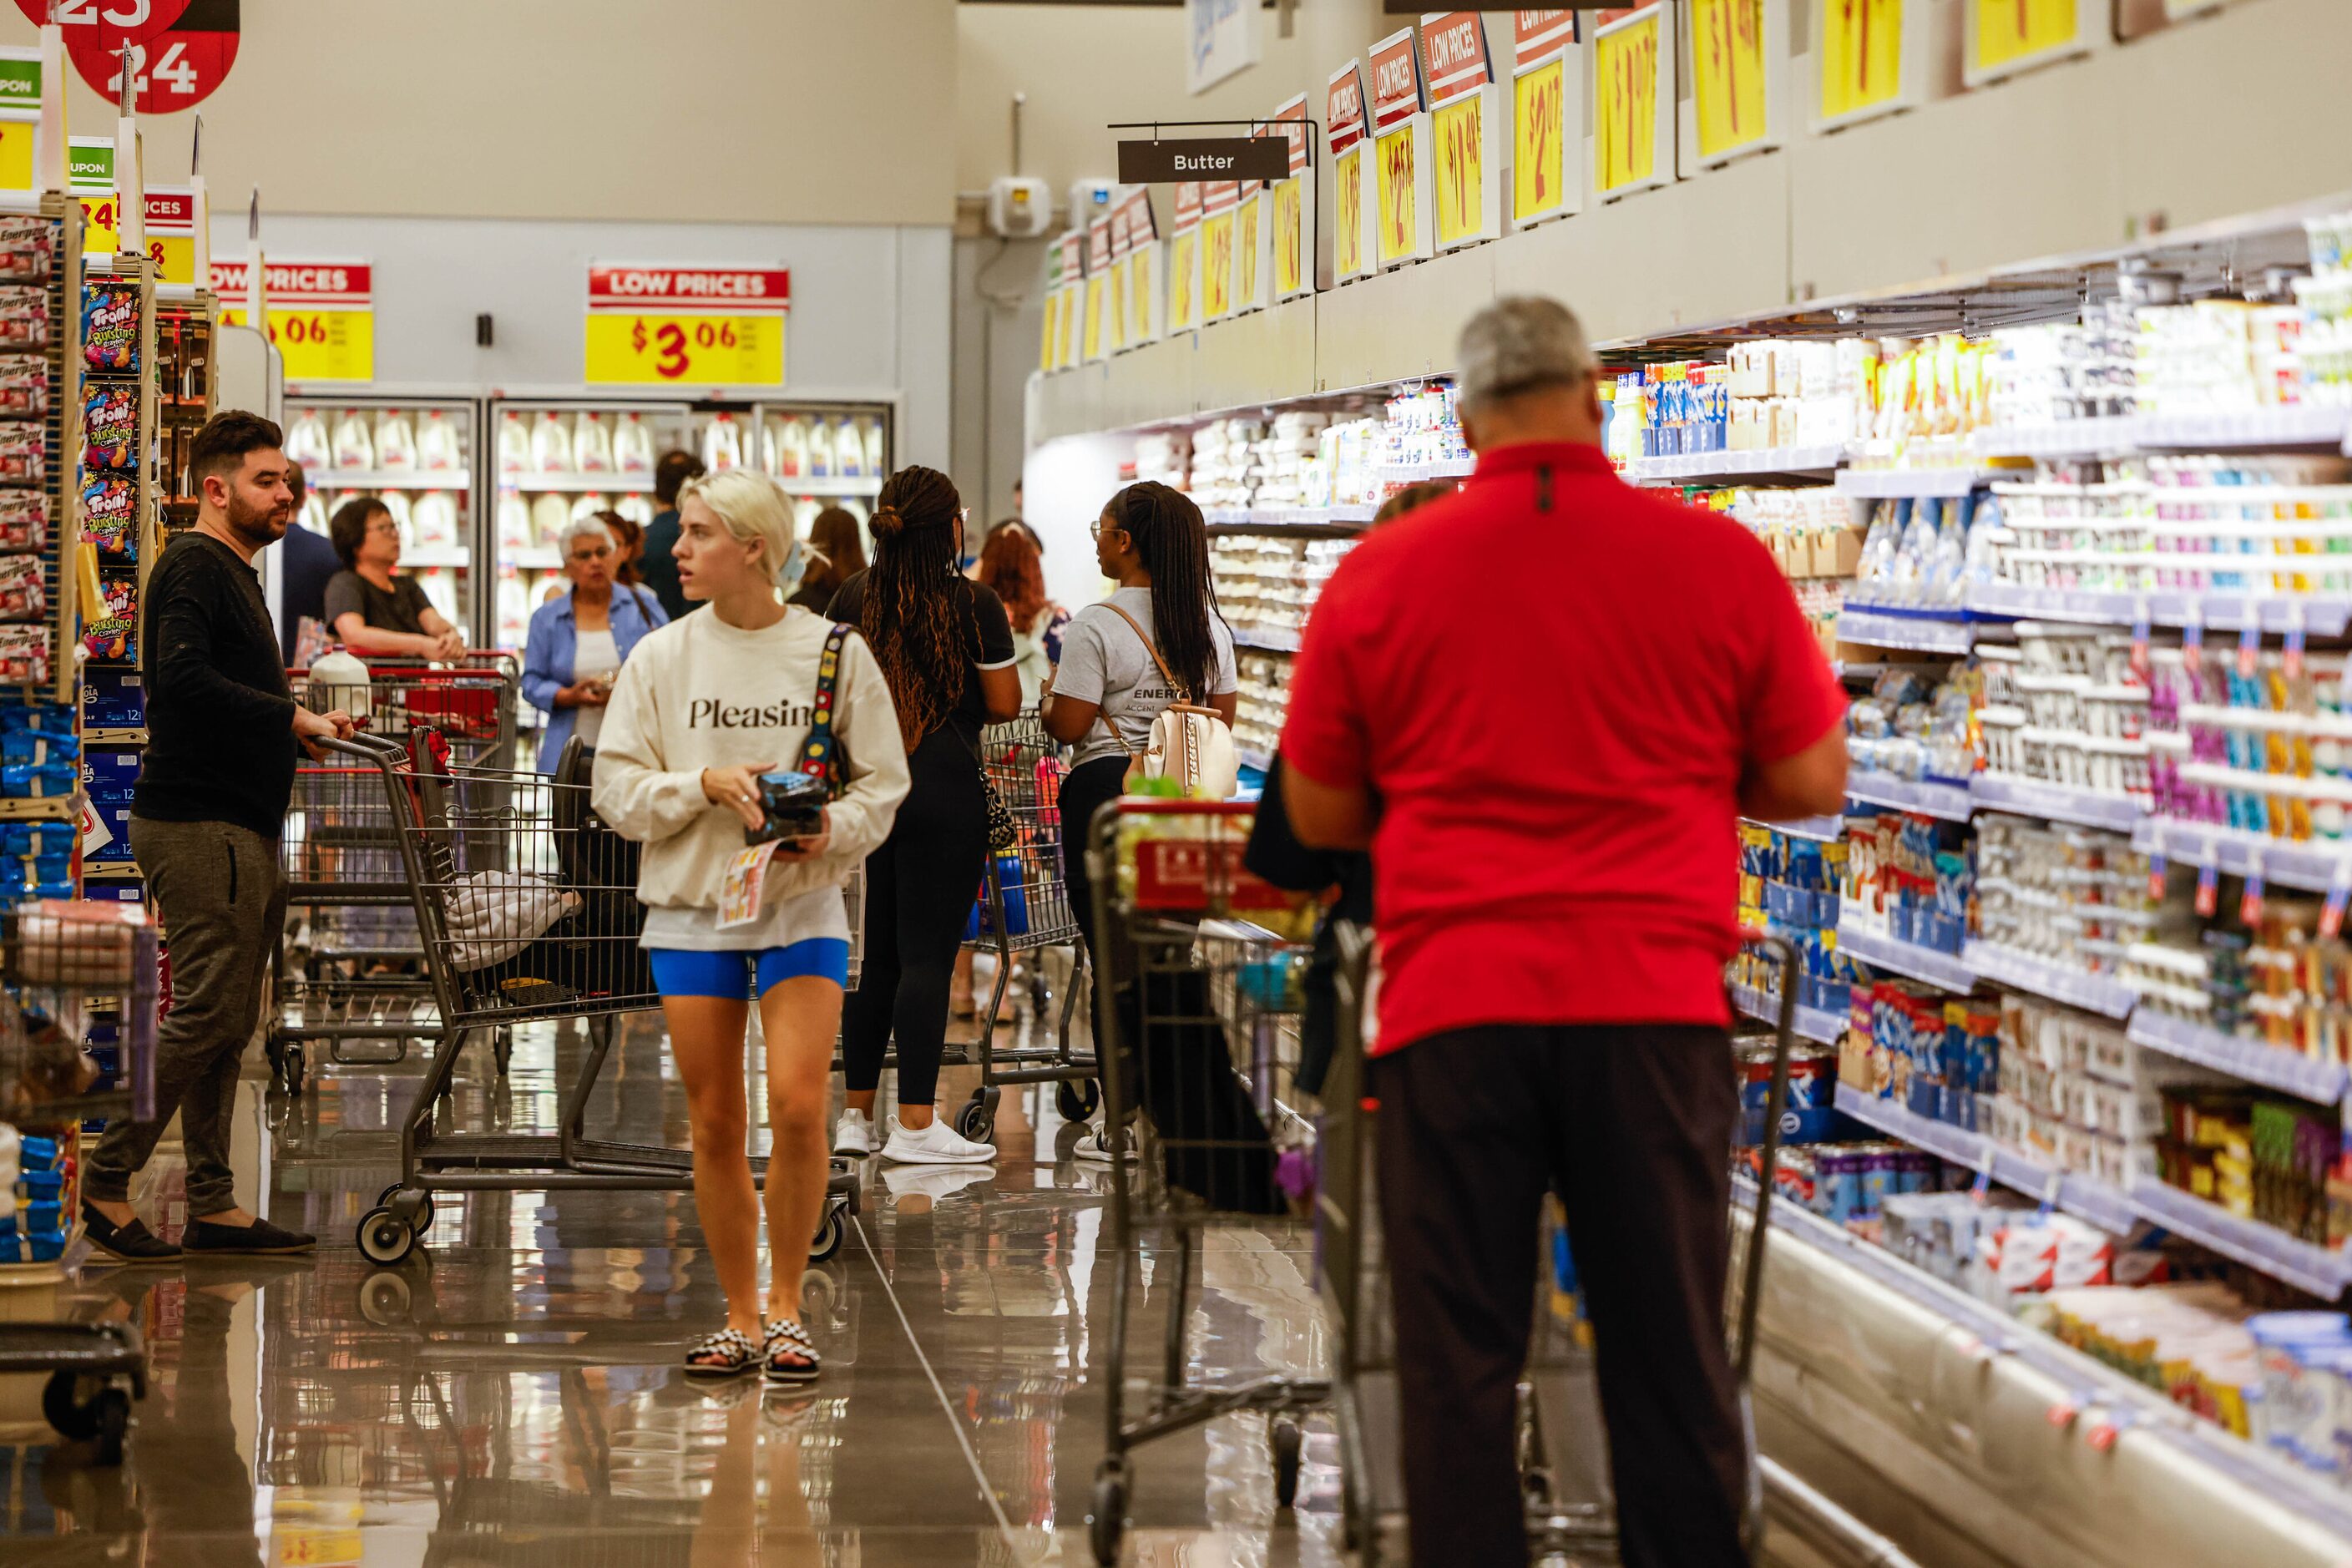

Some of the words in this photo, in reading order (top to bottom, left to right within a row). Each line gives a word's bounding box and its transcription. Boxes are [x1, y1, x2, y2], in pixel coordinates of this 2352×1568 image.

[1430, 30, 1449, 70] LOW
[1448, 21, 1475, 66] PRICES
[108, 43, 197, 94] 24
[1376, 63, 1391, 99] LOW
[1174, 154, 1234, 170] Butter
[610, 272, 671, 293] LOW
[675, 274, 766, 296] PRICES
[90, 301, 130, 326] Trolli
[88, 490, 126, 513] Trolli
[127, 710, 139, 721] 12
[689, 698, 813, 728] Pleasin
[124, 789, 134, 800] 12
